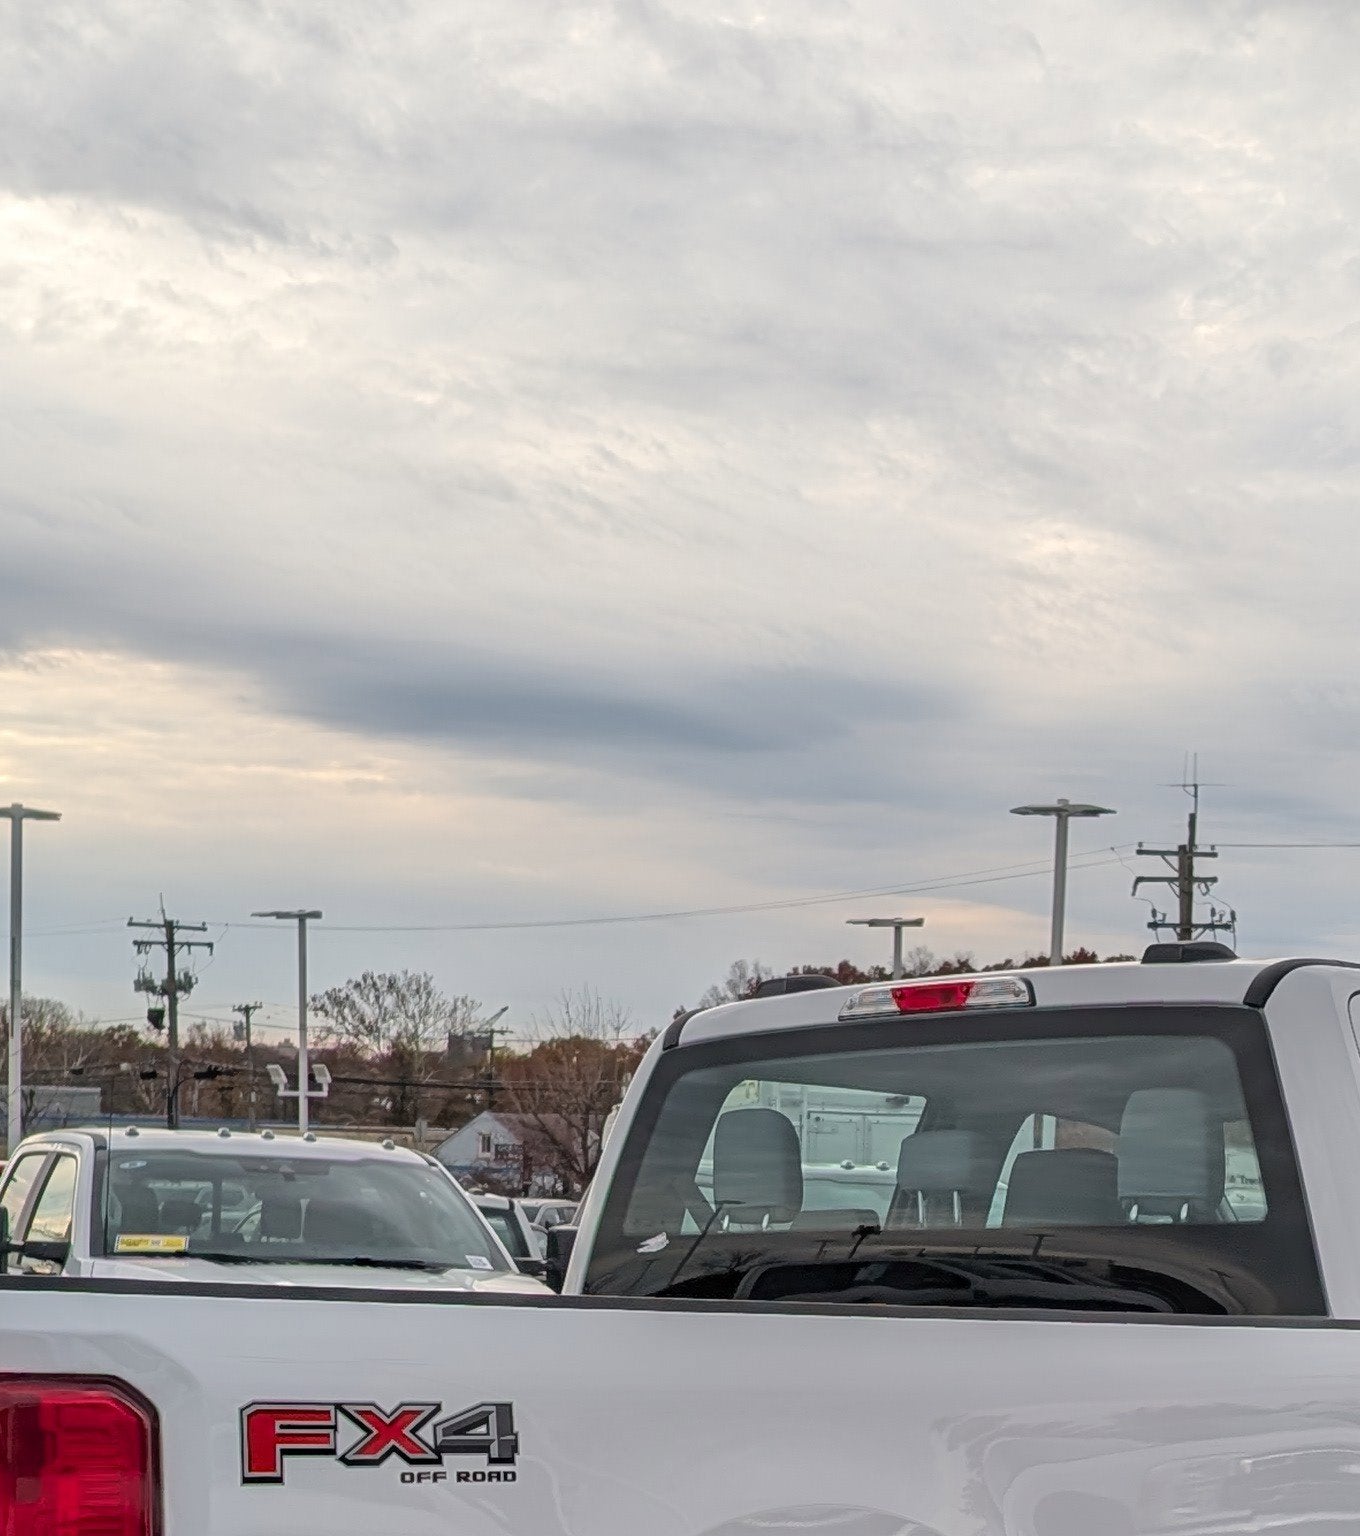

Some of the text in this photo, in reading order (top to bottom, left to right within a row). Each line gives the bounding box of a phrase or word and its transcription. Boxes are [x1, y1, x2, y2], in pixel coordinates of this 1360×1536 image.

[240, 1401, 519, 1485] FX4
[400, 1470, 517, 1484] OFF ROAD
